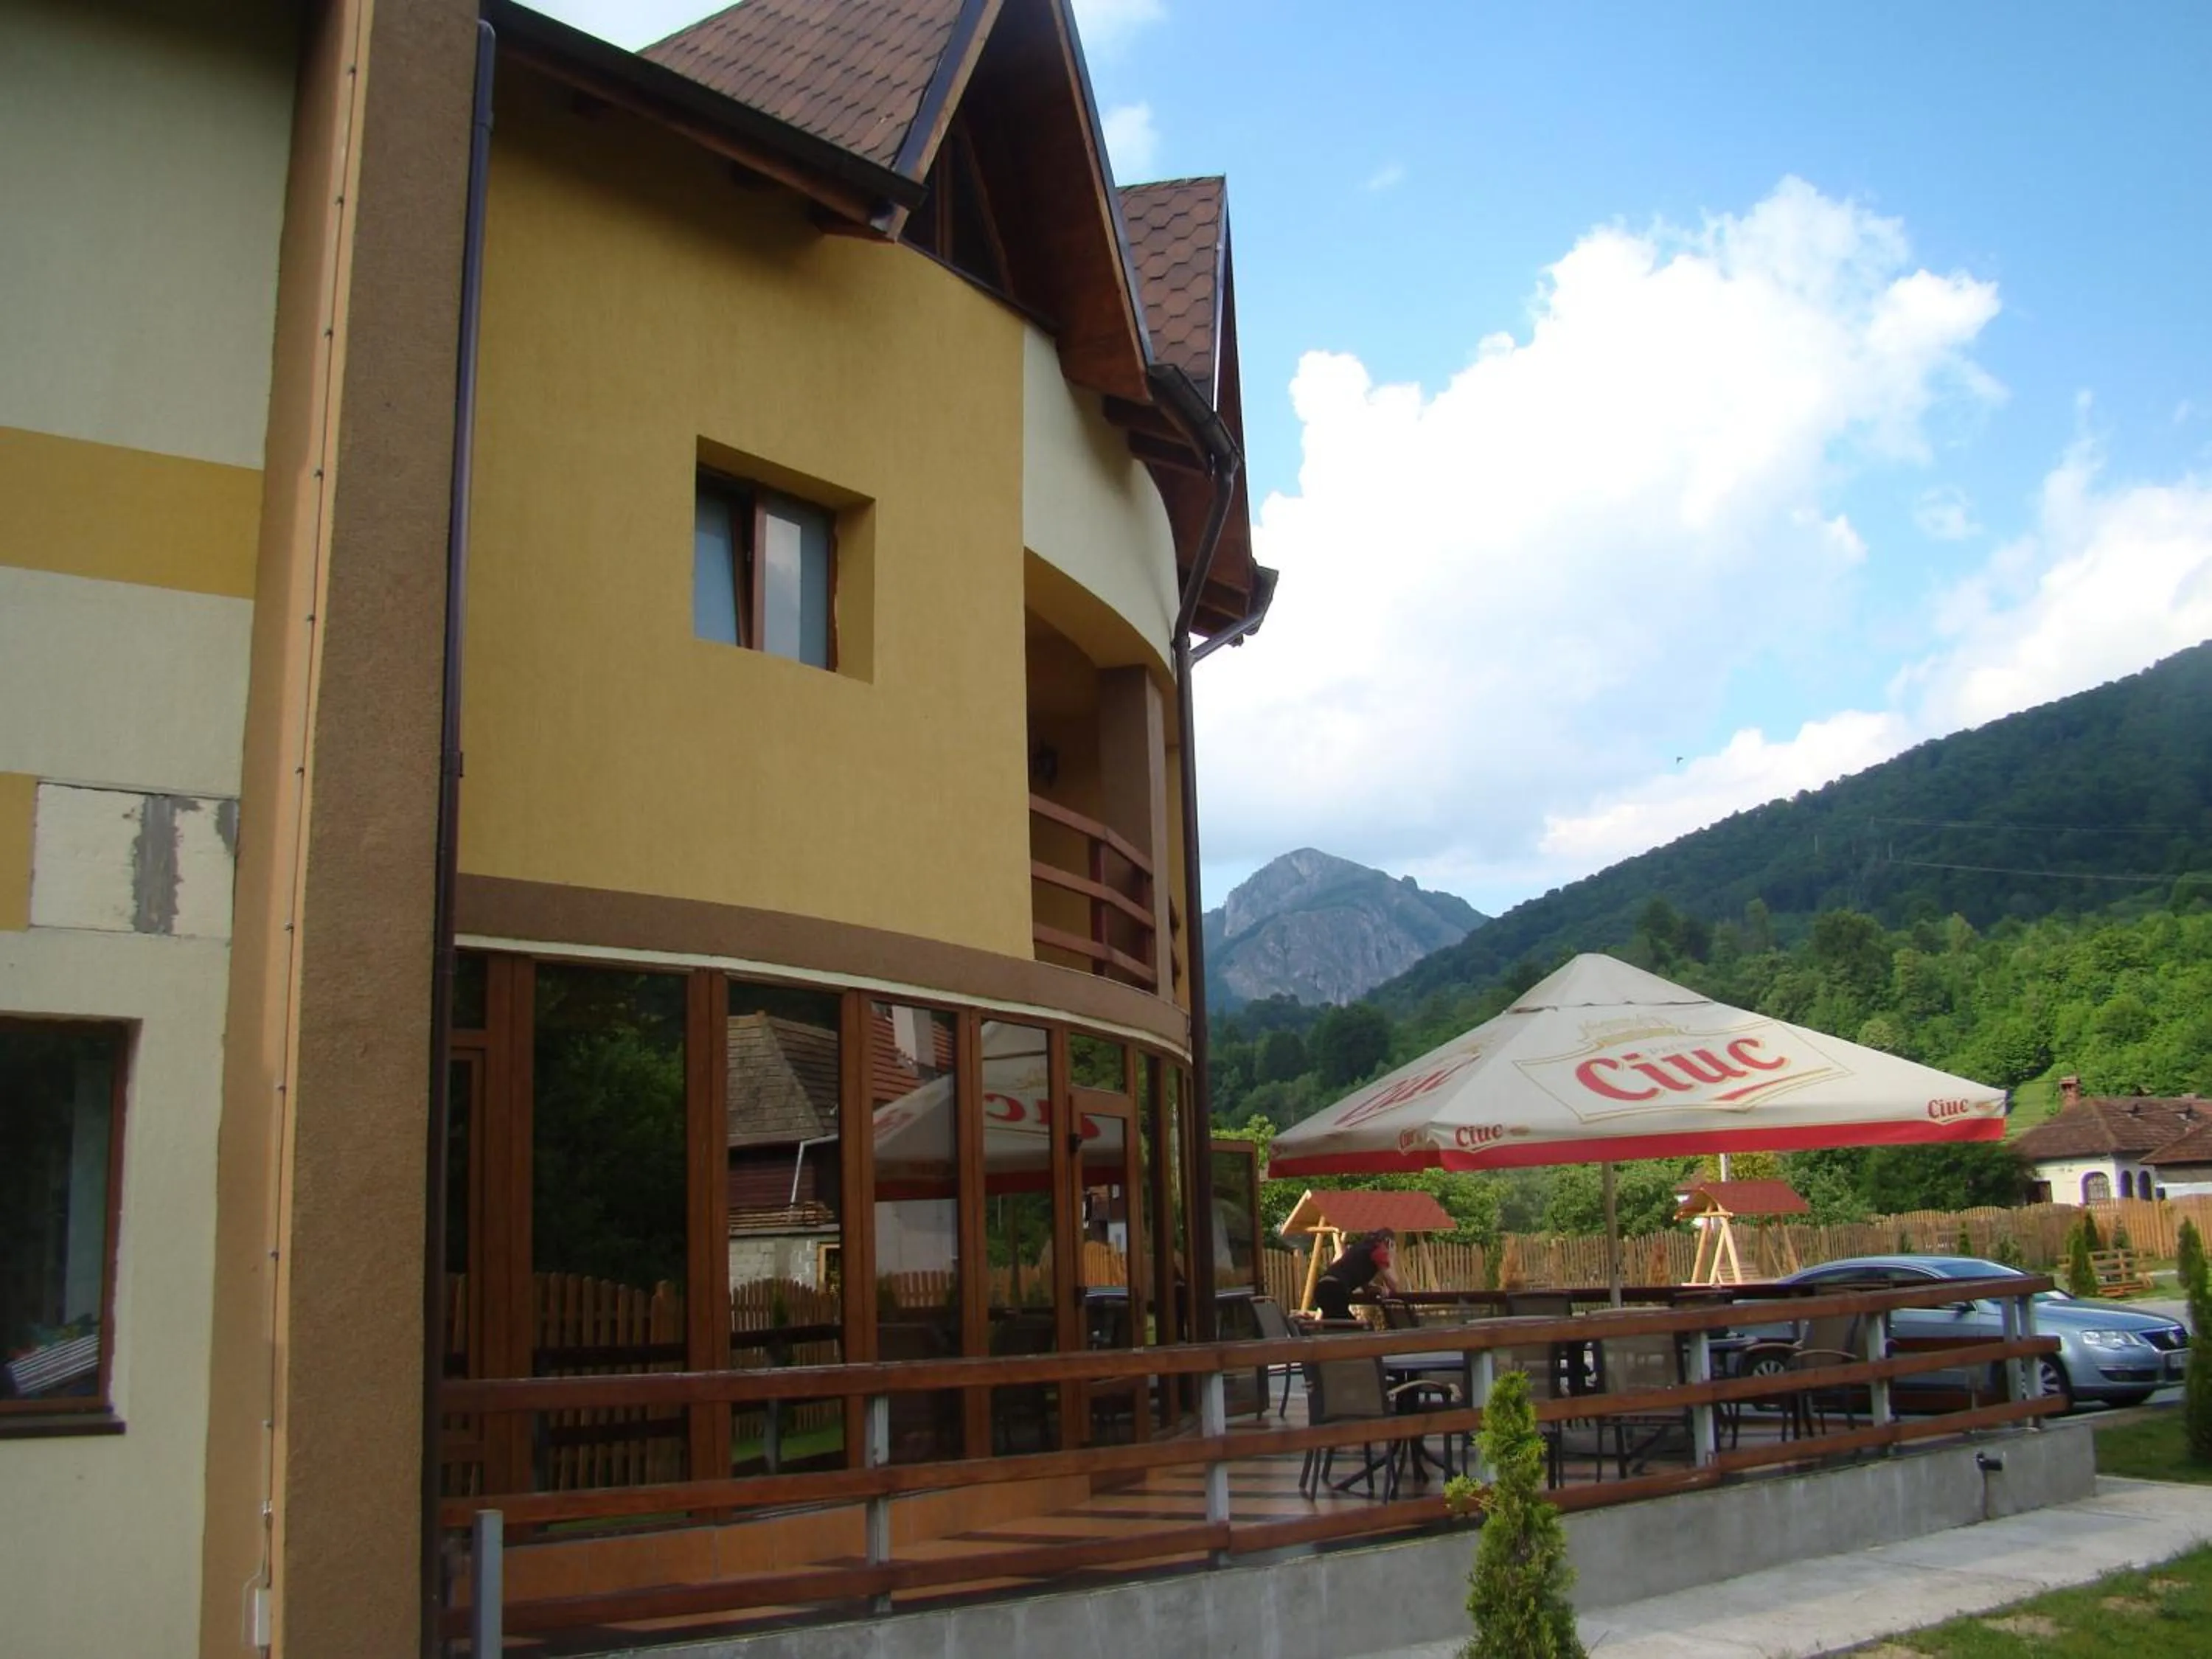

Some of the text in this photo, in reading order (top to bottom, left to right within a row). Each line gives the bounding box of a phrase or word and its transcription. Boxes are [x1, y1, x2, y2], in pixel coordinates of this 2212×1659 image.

[1575, 1038, 1786, 1101] Ciuc
[1927, 1098, 1969, 1119] Ciuc
[1455, 1124, 1503, 1147] Ciuc
